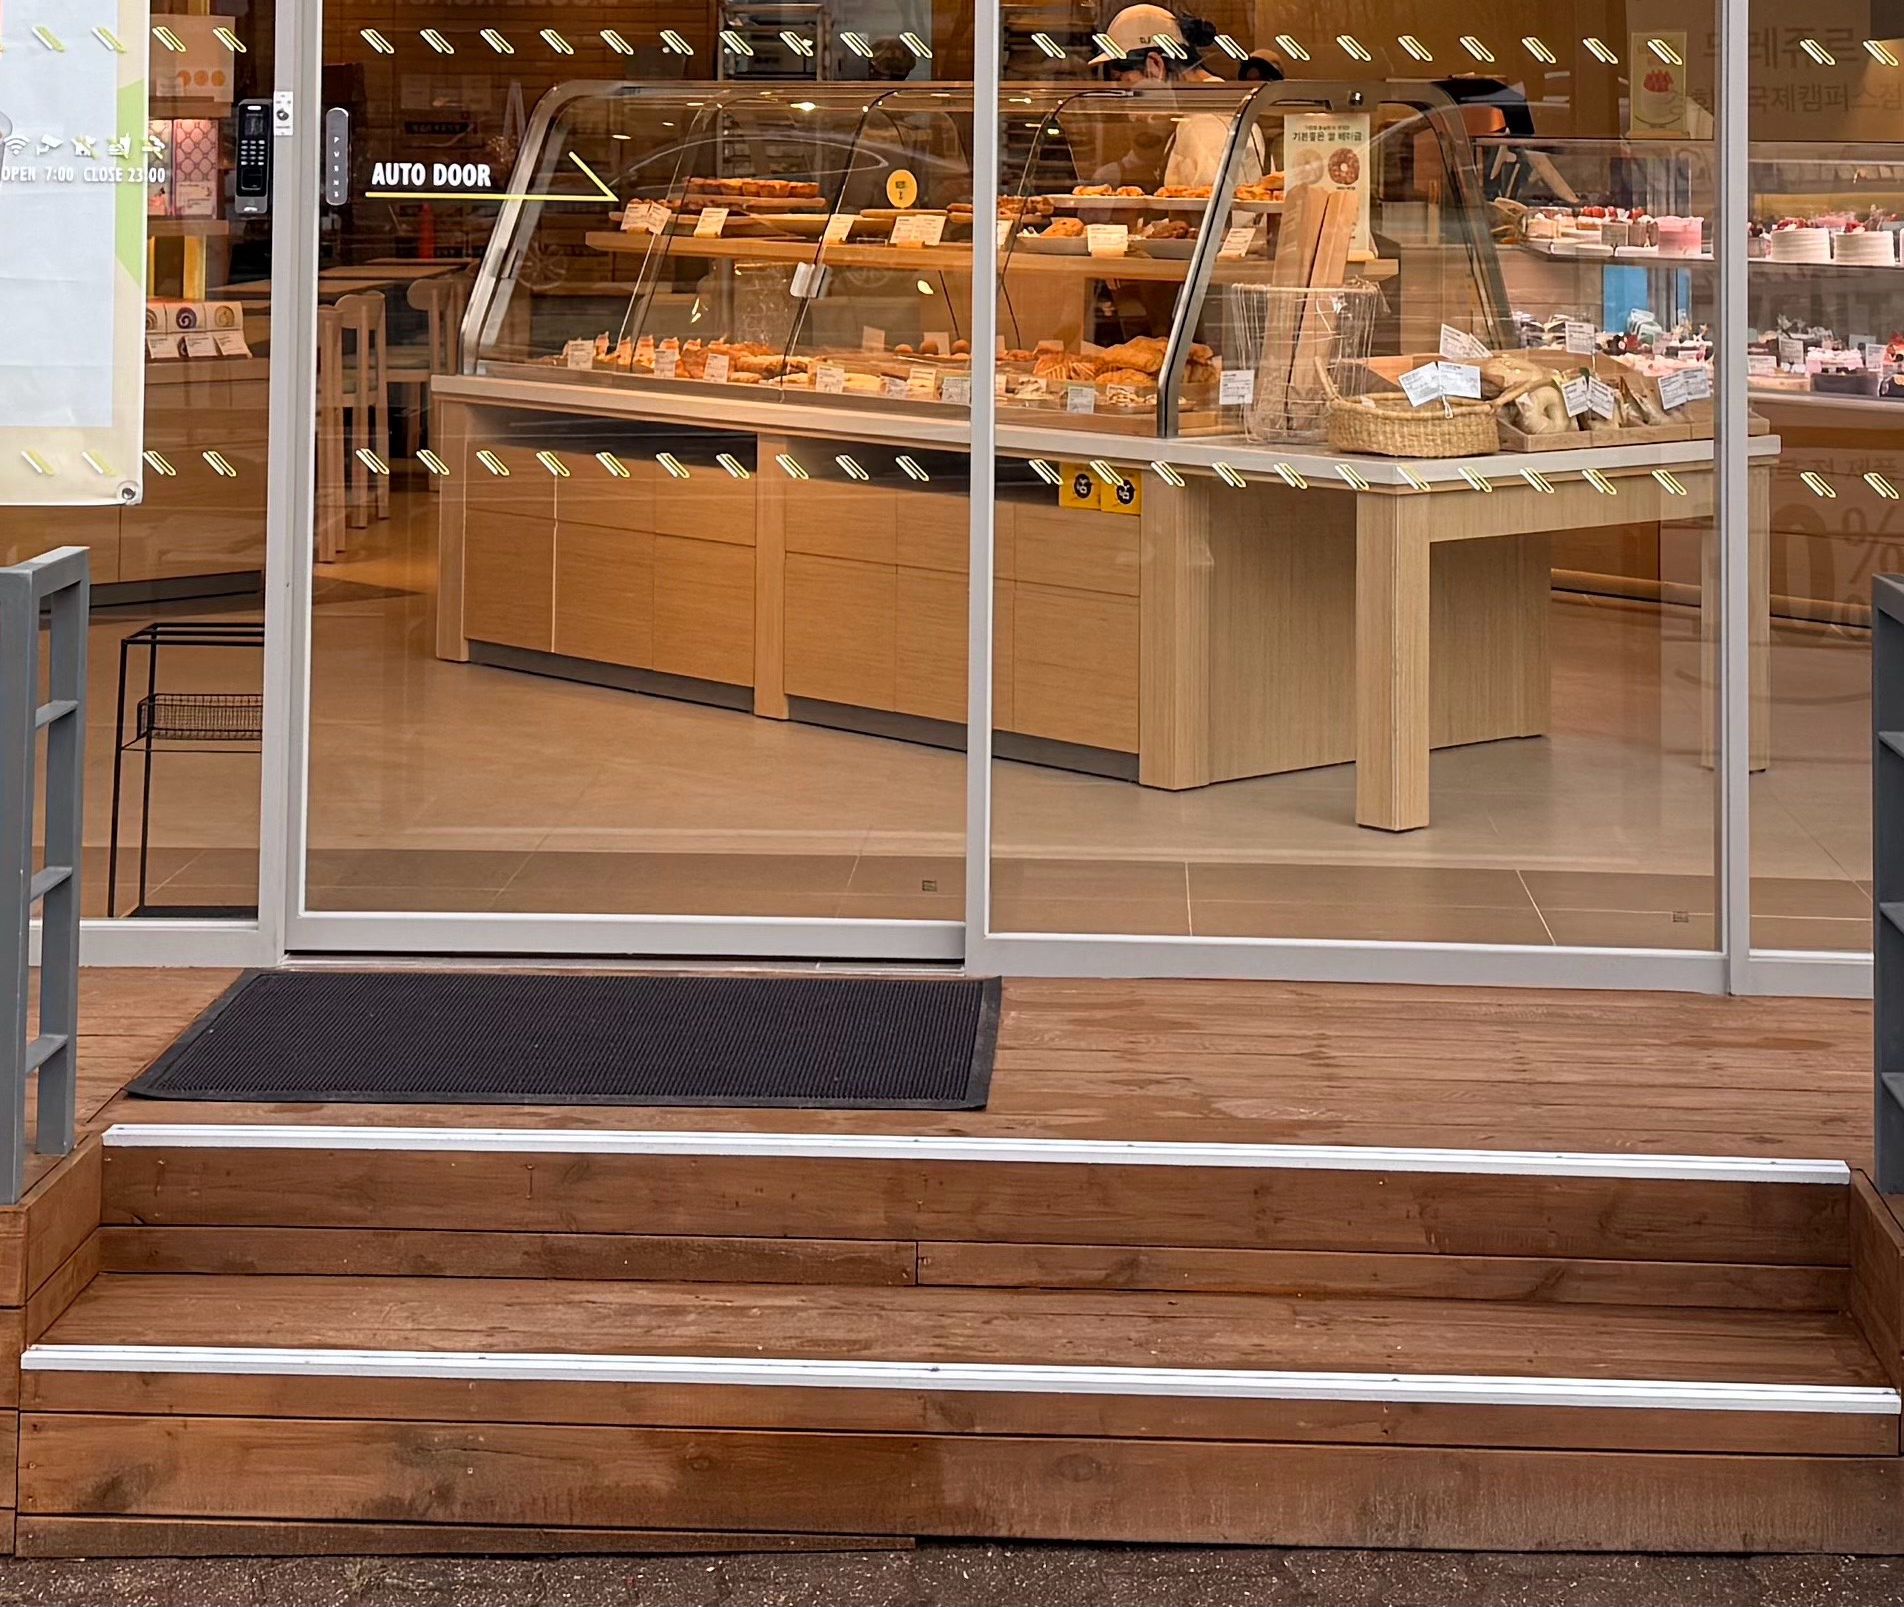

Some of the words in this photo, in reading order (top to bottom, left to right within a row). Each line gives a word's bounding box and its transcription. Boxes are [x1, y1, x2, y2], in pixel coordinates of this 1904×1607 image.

[2, 167, 36, 182] OPEN
[46, 167, 74, 182] 7:00
[84, 168, 123, 182] CLOSE
[372, 162, 426, 186] AUTO
[433, 164, 492, 187] DOOR
